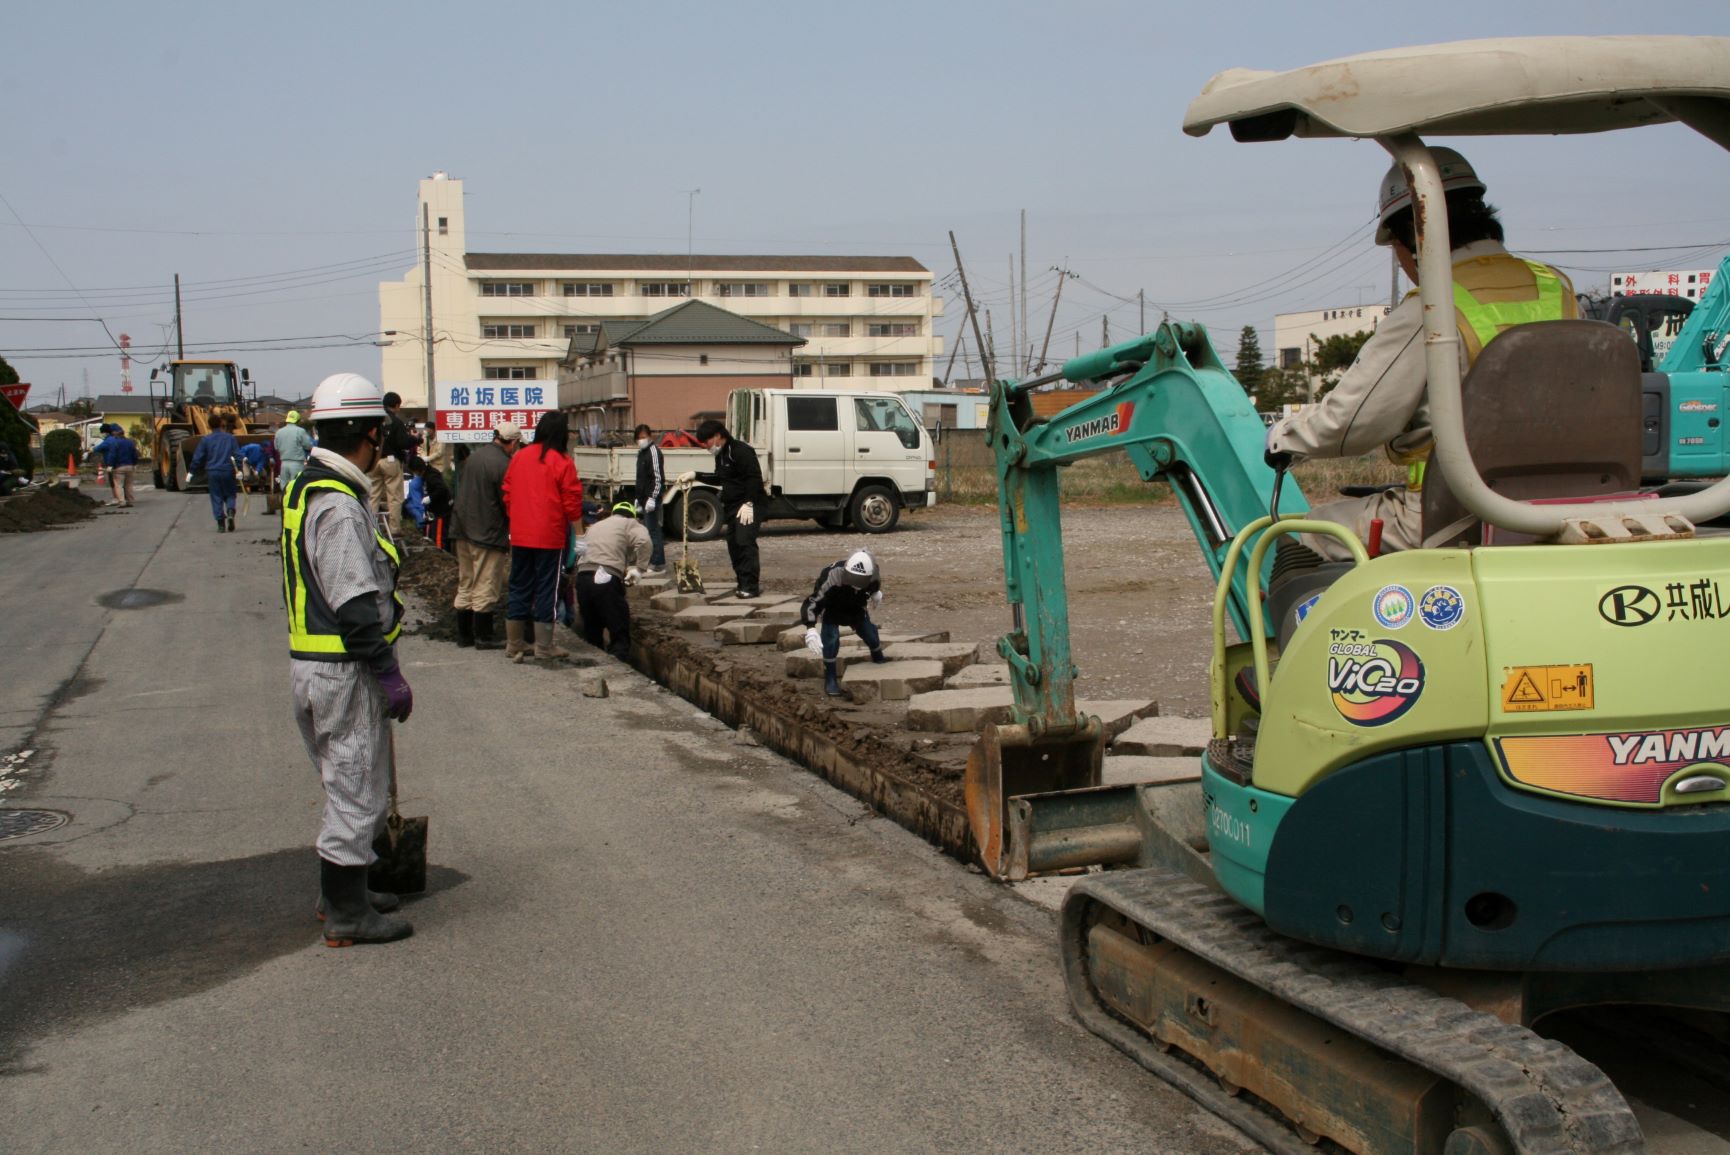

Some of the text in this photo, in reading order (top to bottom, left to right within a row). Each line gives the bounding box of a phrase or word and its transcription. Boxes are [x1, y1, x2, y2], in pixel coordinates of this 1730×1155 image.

[450, 387, 544, 406] 船坂医院
[1065, 412, 1120, 444] YANMAR
[1330, 629, 1366, 641] ヤンマー
[1329, 643, 1377, 657] GLOBAL
